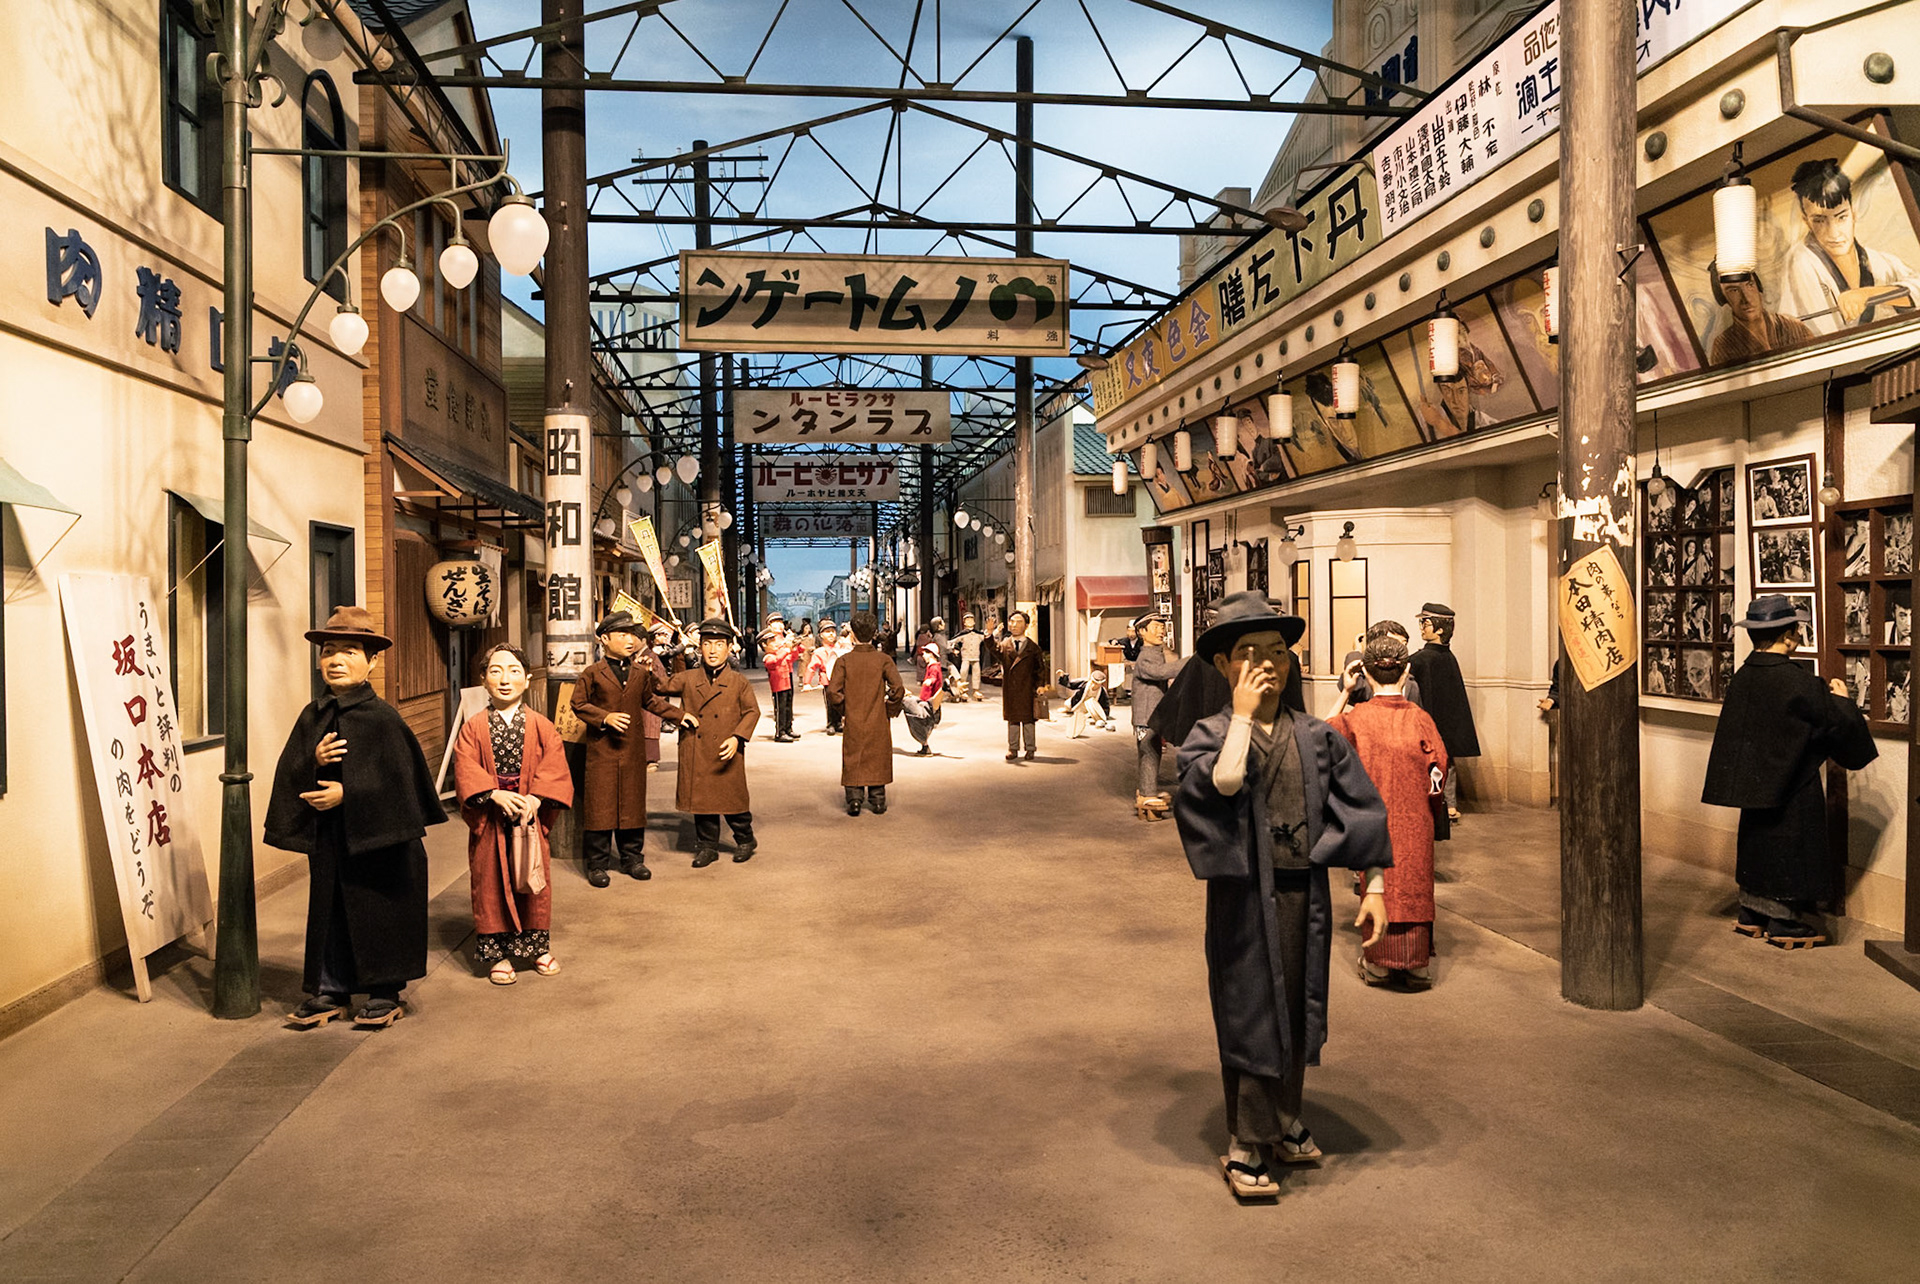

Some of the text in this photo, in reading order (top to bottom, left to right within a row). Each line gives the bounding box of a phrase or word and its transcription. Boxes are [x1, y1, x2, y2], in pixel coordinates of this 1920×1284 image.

[1431, 114, 1452, 191] 山田五十鈴
[1454, 93, 1475, 175] 伊藤大輔
[1566, 578, 1625, 672] 本田精肉店
[112, 634, 172, 848] 坂口本店
[139, 601, 182, 793] うまいと評判の
[111, 737, 155, 921] の肉をどうぞ
